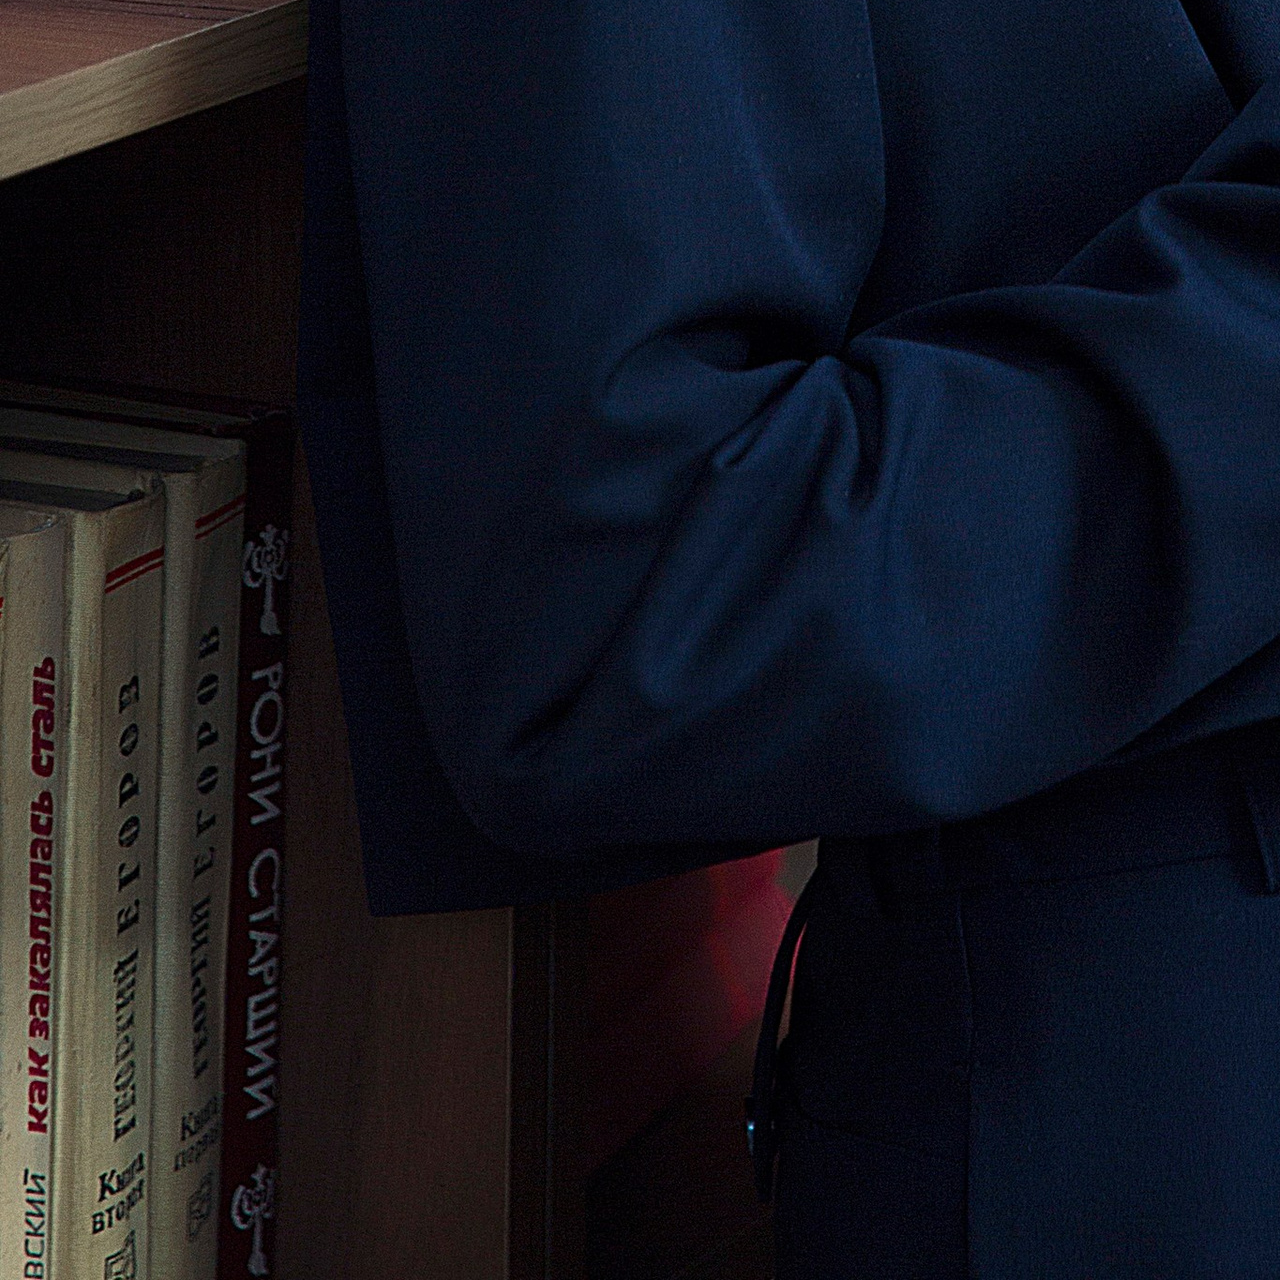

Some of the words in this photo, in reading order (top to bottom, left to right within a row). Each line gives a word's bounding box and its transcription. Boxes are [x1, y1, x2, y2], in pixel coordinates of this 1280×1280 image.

[31, 656, 56, 779] сталь
[117, 675, 140, 937] ЕГОРОВ
[194, 626, 219, 879] ЕГОРОВ
[249, 662, 283, 825] РОНИ
[28, 789, 54, 1041] закалялась
[27, 1046, 50, 1134] как
[113, 948, 139, 1141] ГЕОРГИЙ
